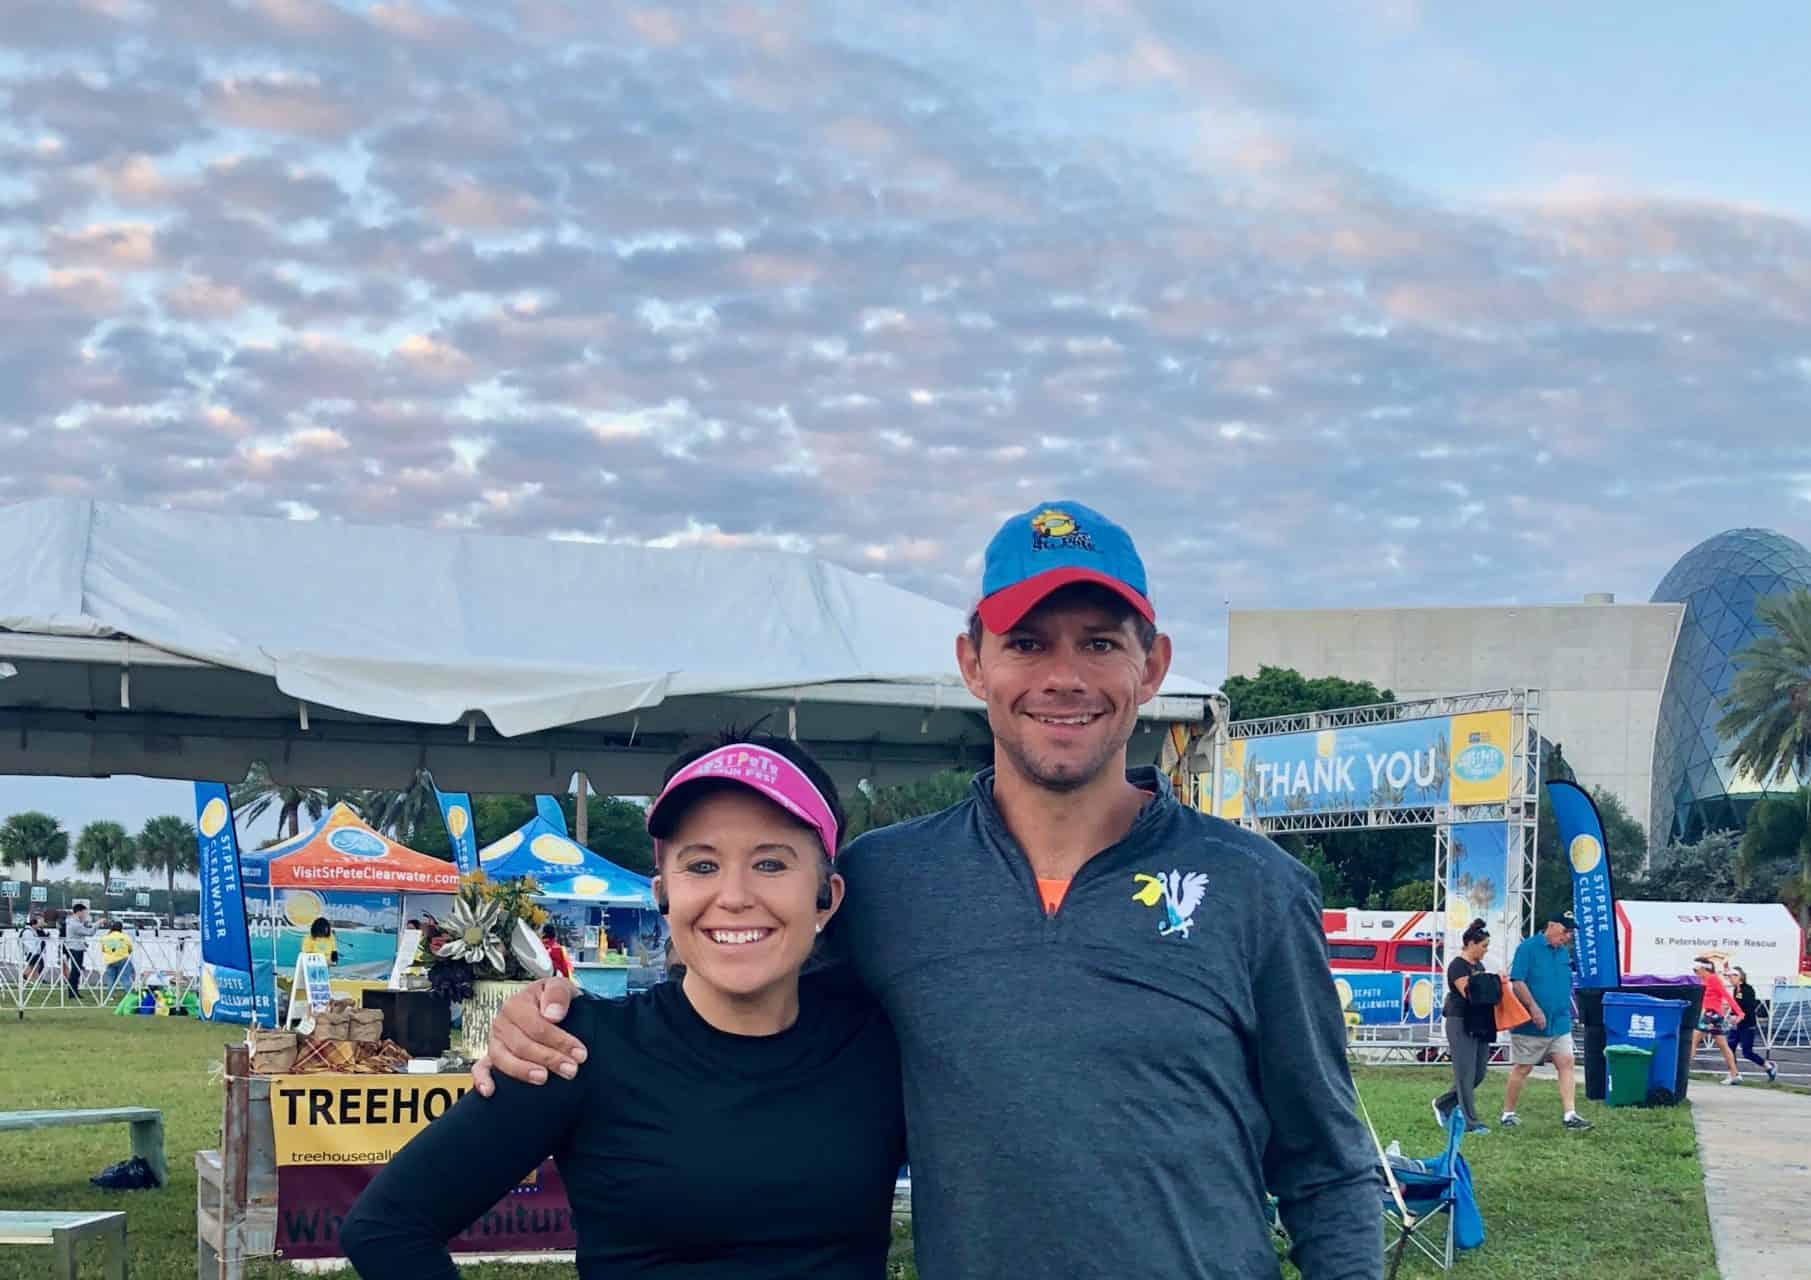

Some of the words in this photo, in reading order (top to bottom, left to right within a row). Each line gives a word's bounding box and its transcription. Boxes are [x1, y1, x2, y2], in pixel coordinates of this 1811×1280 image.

[1256, 756, 1354, 798] THANK
[1366, 748, 1436, 789] YOU
[210, 838, 227, 939] CLEARWATER
[220, 835, 236, 893] ST.PETE
[292, 866, 460, 885] VisitStPeteClearwater.com
[1579, 877, 1598, 976] CLEARWATER
[1593, 874, 1609, 932] ST.PETE
[1668, 937, 1718, 948] Petersburg
[1722, 938, 1740, 948] Fire
[1744, 939, 1777, 948] Rescue
[291, 1149, 397, 1164] treehousegall
